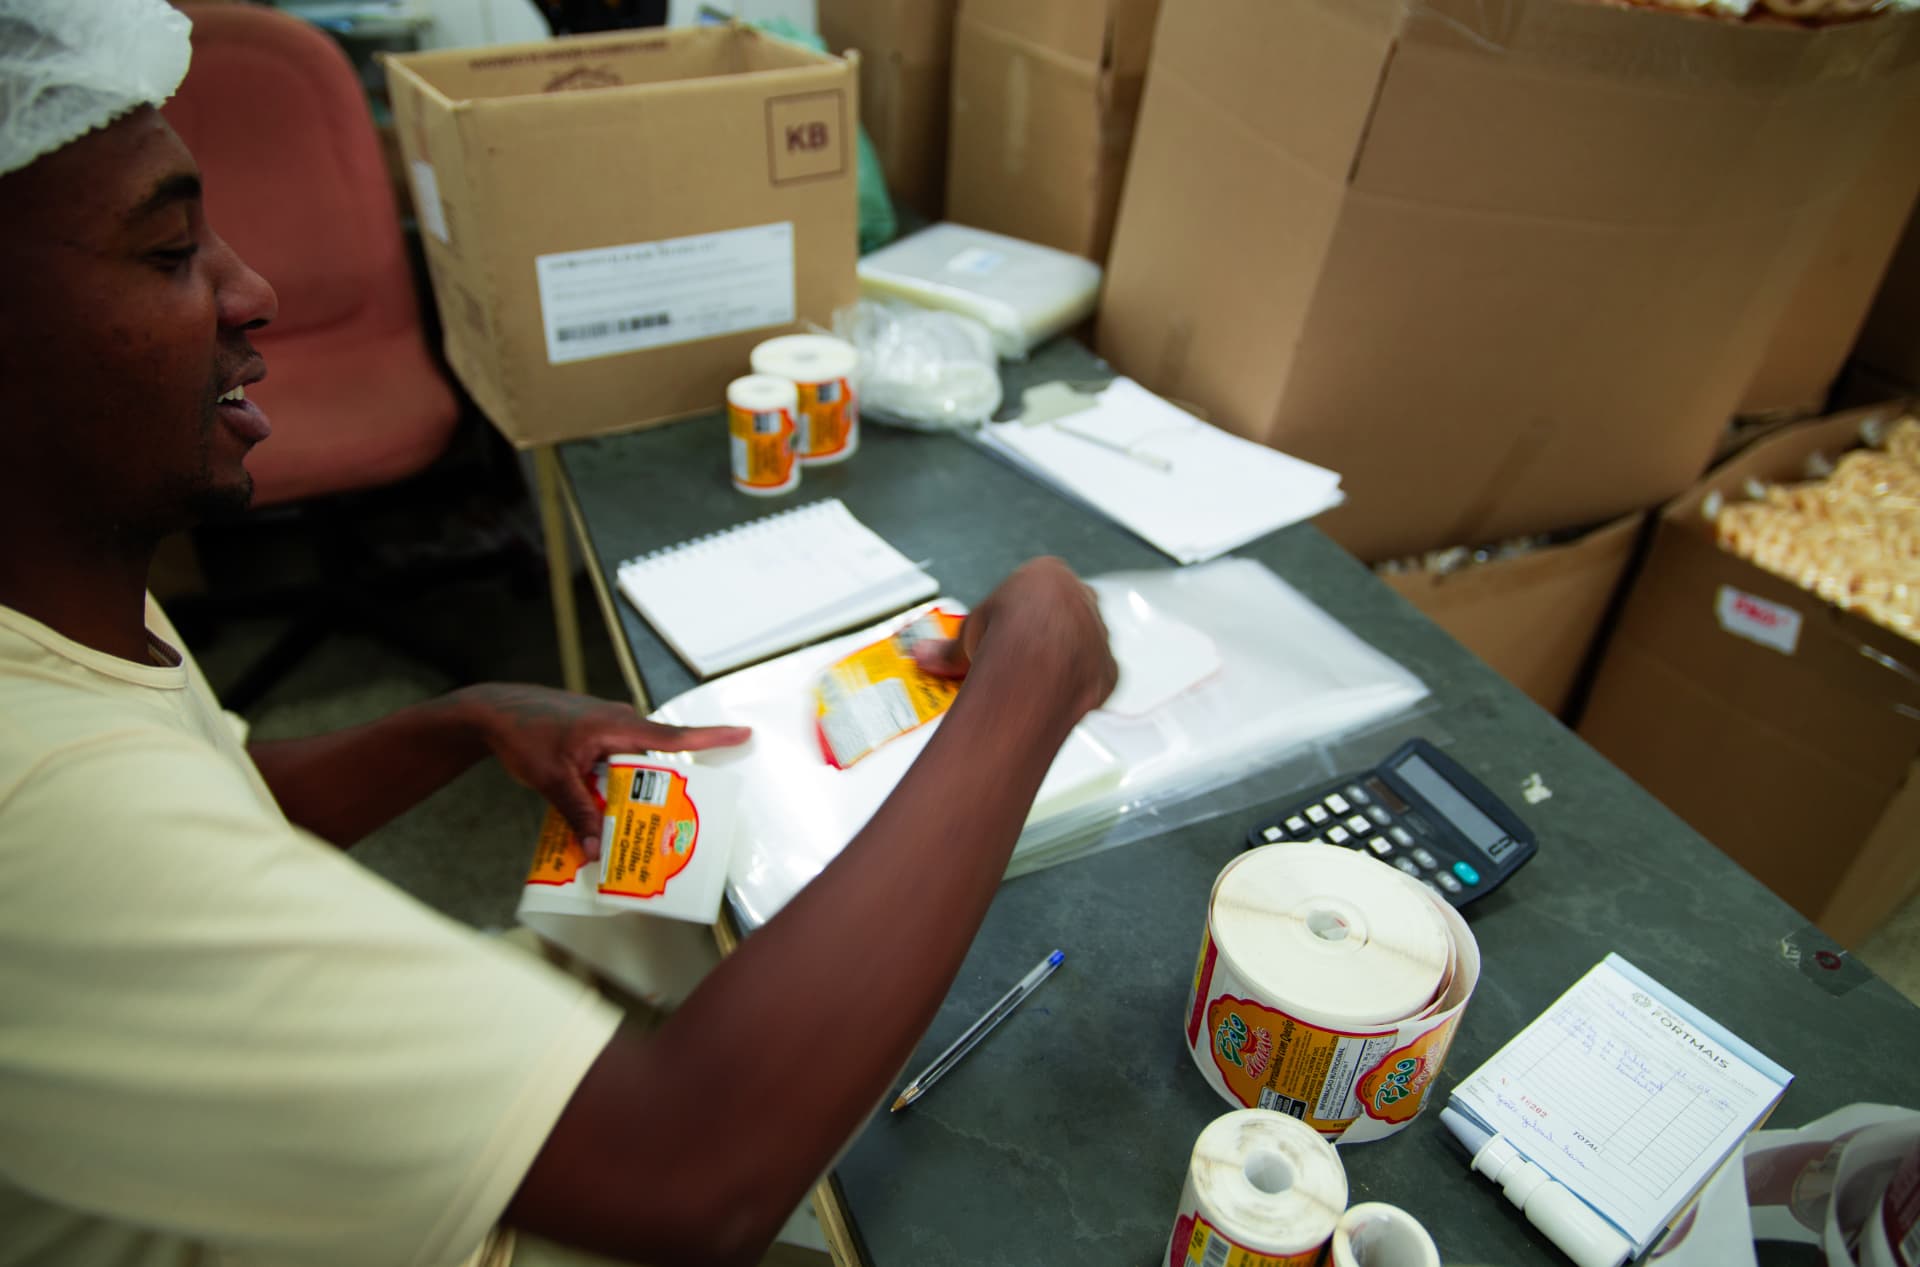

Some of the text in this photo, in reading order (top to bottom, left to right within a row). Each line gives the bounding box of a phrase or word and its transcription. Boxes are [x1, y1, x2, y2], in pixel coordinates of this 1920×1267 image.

[786, 121, 829, 153] KB
[614, 808, 634, 881] com Queijo
[627, 819, 646, 873] Polvilho
[639, 813, 660, 883] Biscoito de
[1279, 1018, 1296, 1042] Queijo
[1651, 1009, 1729, 1069] FORTMAIS
[1278, 1039, 1288, 1056] com
[1329, 1045, 1345, 1079] NUTRICIONAL
[1265, 1054, 1284, 1088] Torradinha
[1572, 1130, 1599, 1153] TOTAL
